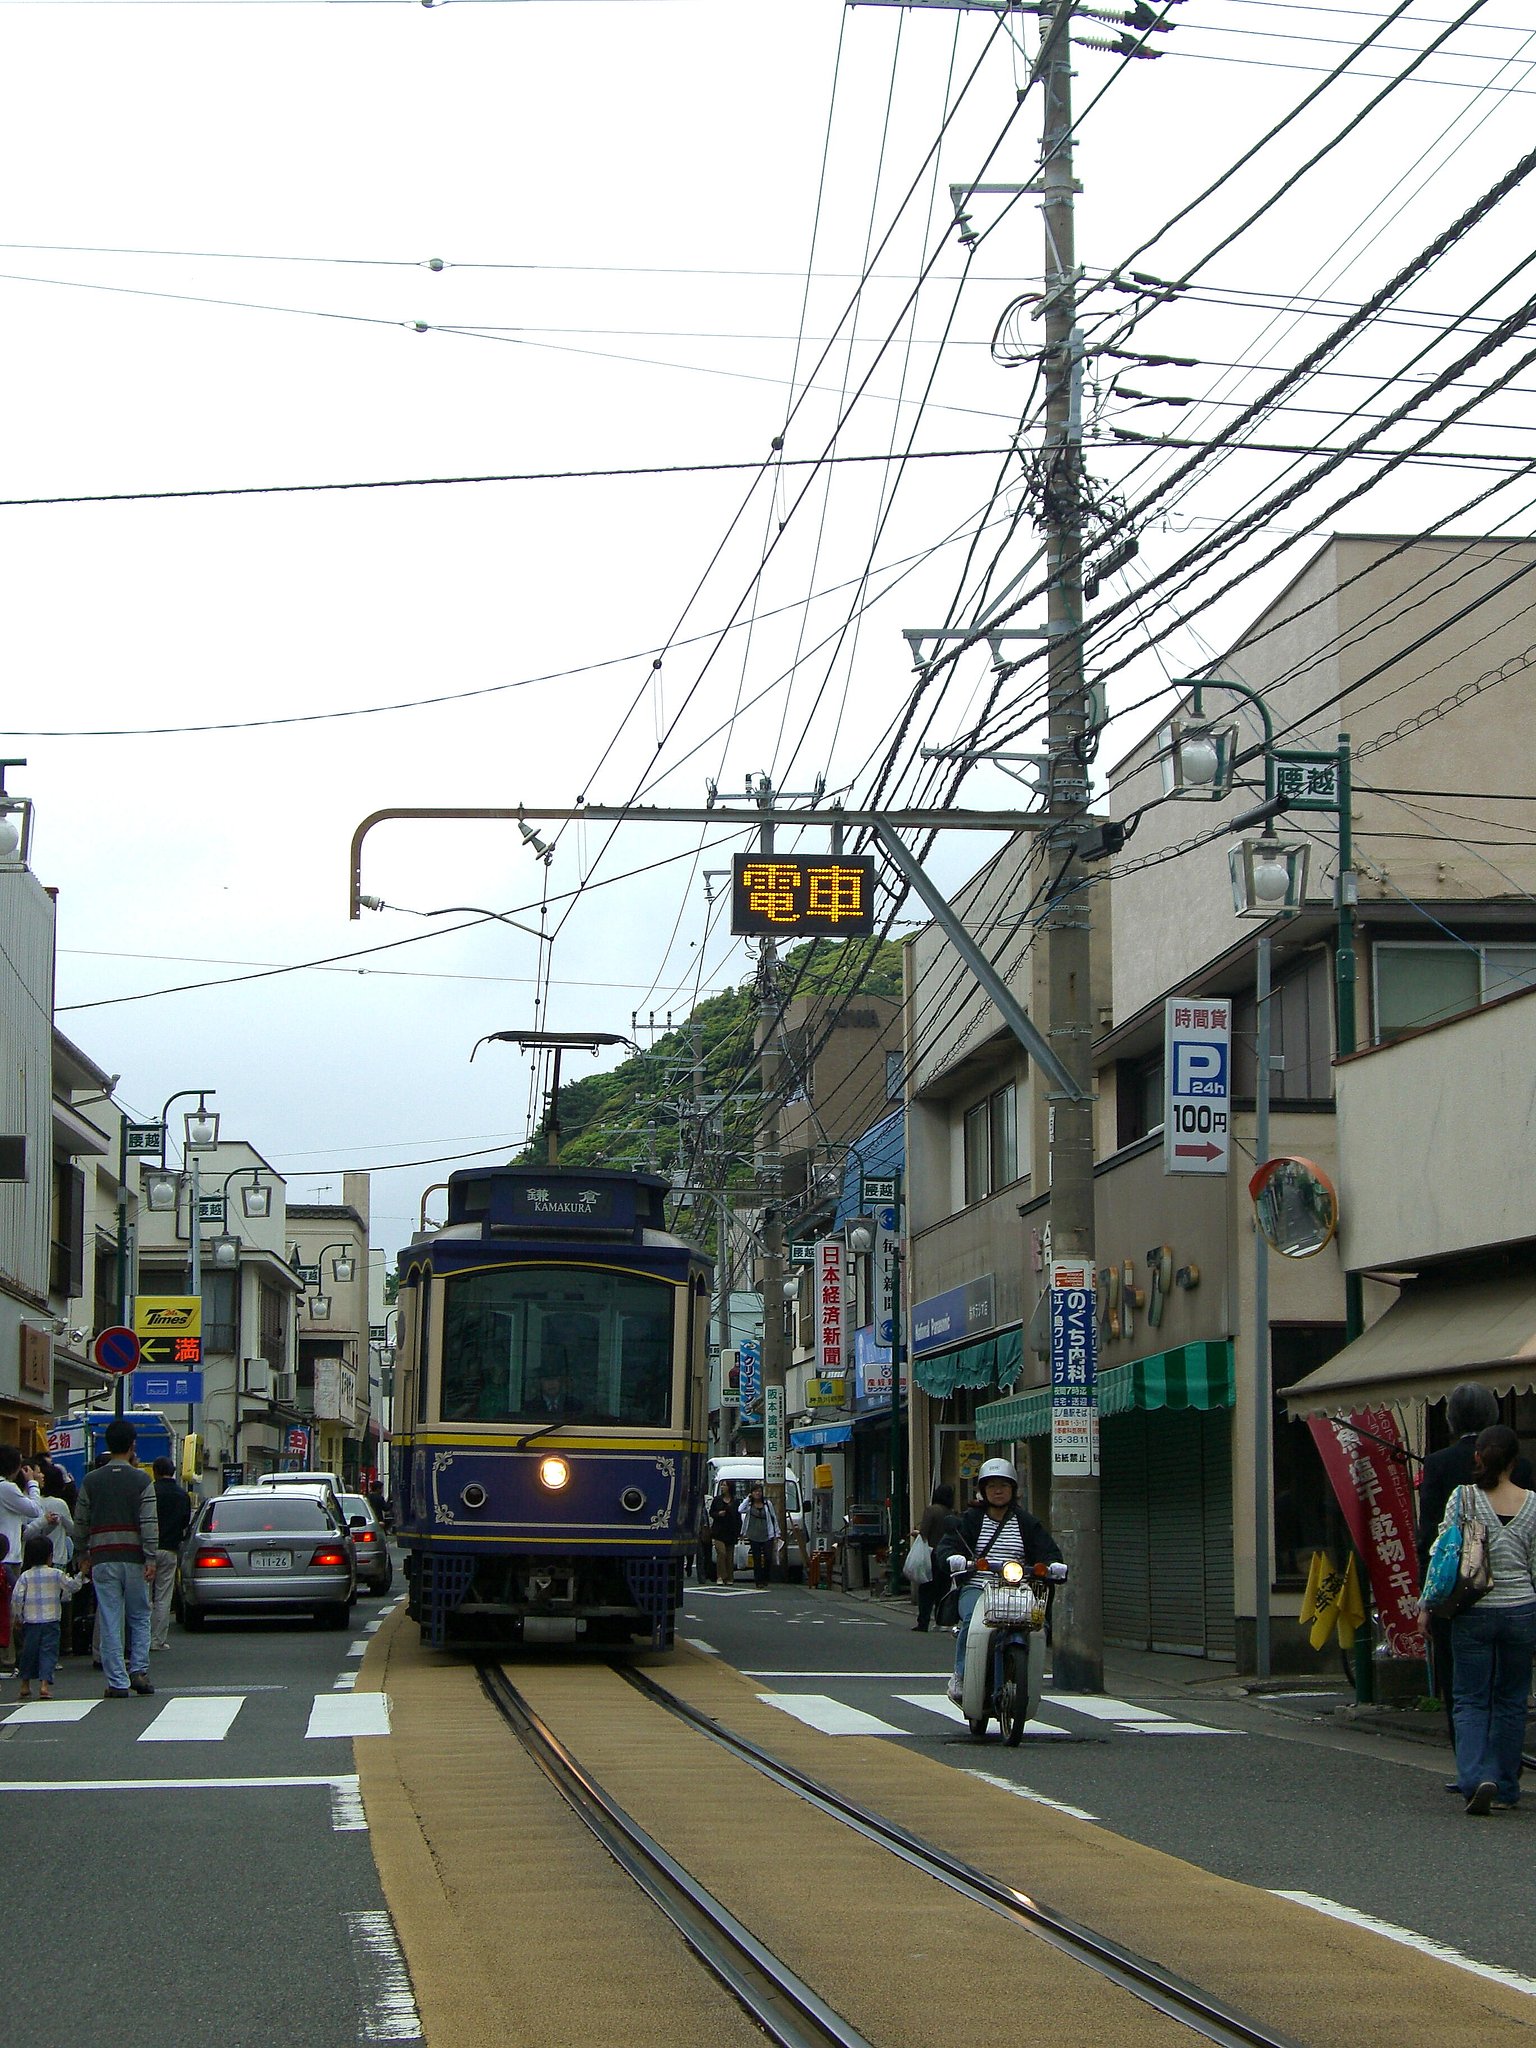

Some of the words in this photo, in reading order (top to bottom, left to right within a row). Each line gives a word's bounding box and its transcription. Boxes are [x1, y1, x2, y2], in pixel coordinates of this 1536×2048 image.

[1278, 766, 1335, 796] 腰越
[743, 863, 865, 923] 電車
[1178, 1044, 1222, 1094] P
[1192, 1082, 1225, 1095] 24h
[1173, 1104, 1227, 1134] 100円
[128, 1133, 160, 1149] 腰越
[526, 1188, 602, 1204] 鎌倉
[865, 1183, 893, 1197] 腰越
[534, 1201, 592, 1213] KAMAKURA
[146, 1310, 189, 1325] Times
[822, 1246, 841, 1366] 日本経済新聞
[174, 1337, 200, 1362] 満
[1053, 1292, 1064, 1384] 江ノ島クリニック
[1067, 1292, 1086, 1384] のぐち内科
[1054, 1435, 1089, 1444] 55-3811
